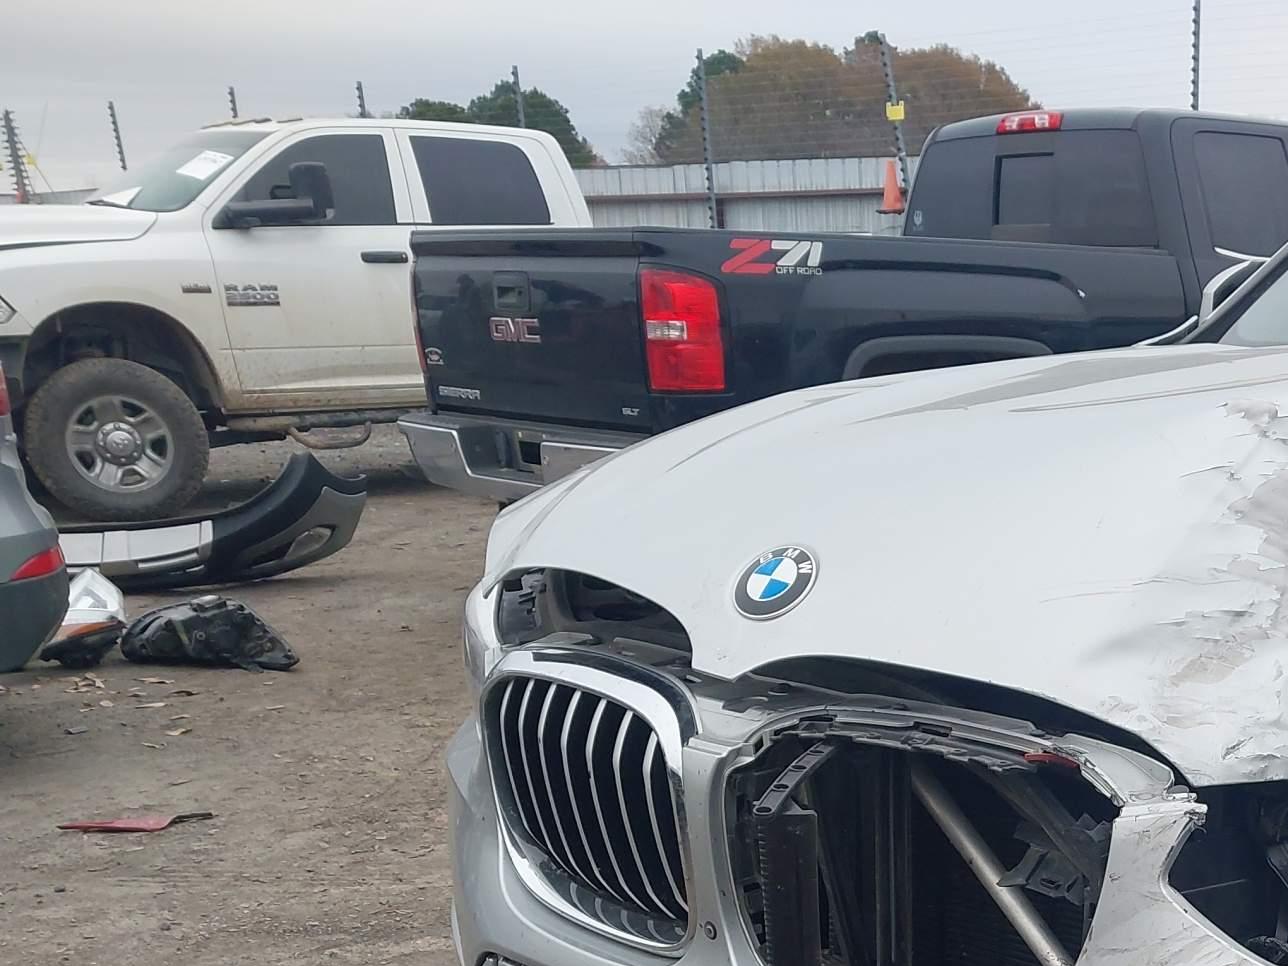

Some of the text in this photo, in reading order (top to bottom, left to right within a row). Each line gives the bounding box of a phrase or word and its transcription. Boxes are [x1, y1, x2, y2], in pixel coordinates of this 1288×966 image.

[721, 238, 823, 274] Z71
[775, 266, 823, 275] OFF ROAD
[223, 284, 278, 292] RAM
[489, 316, 542, 343] GMC
[438, 385, 481, 400] SIERRA
